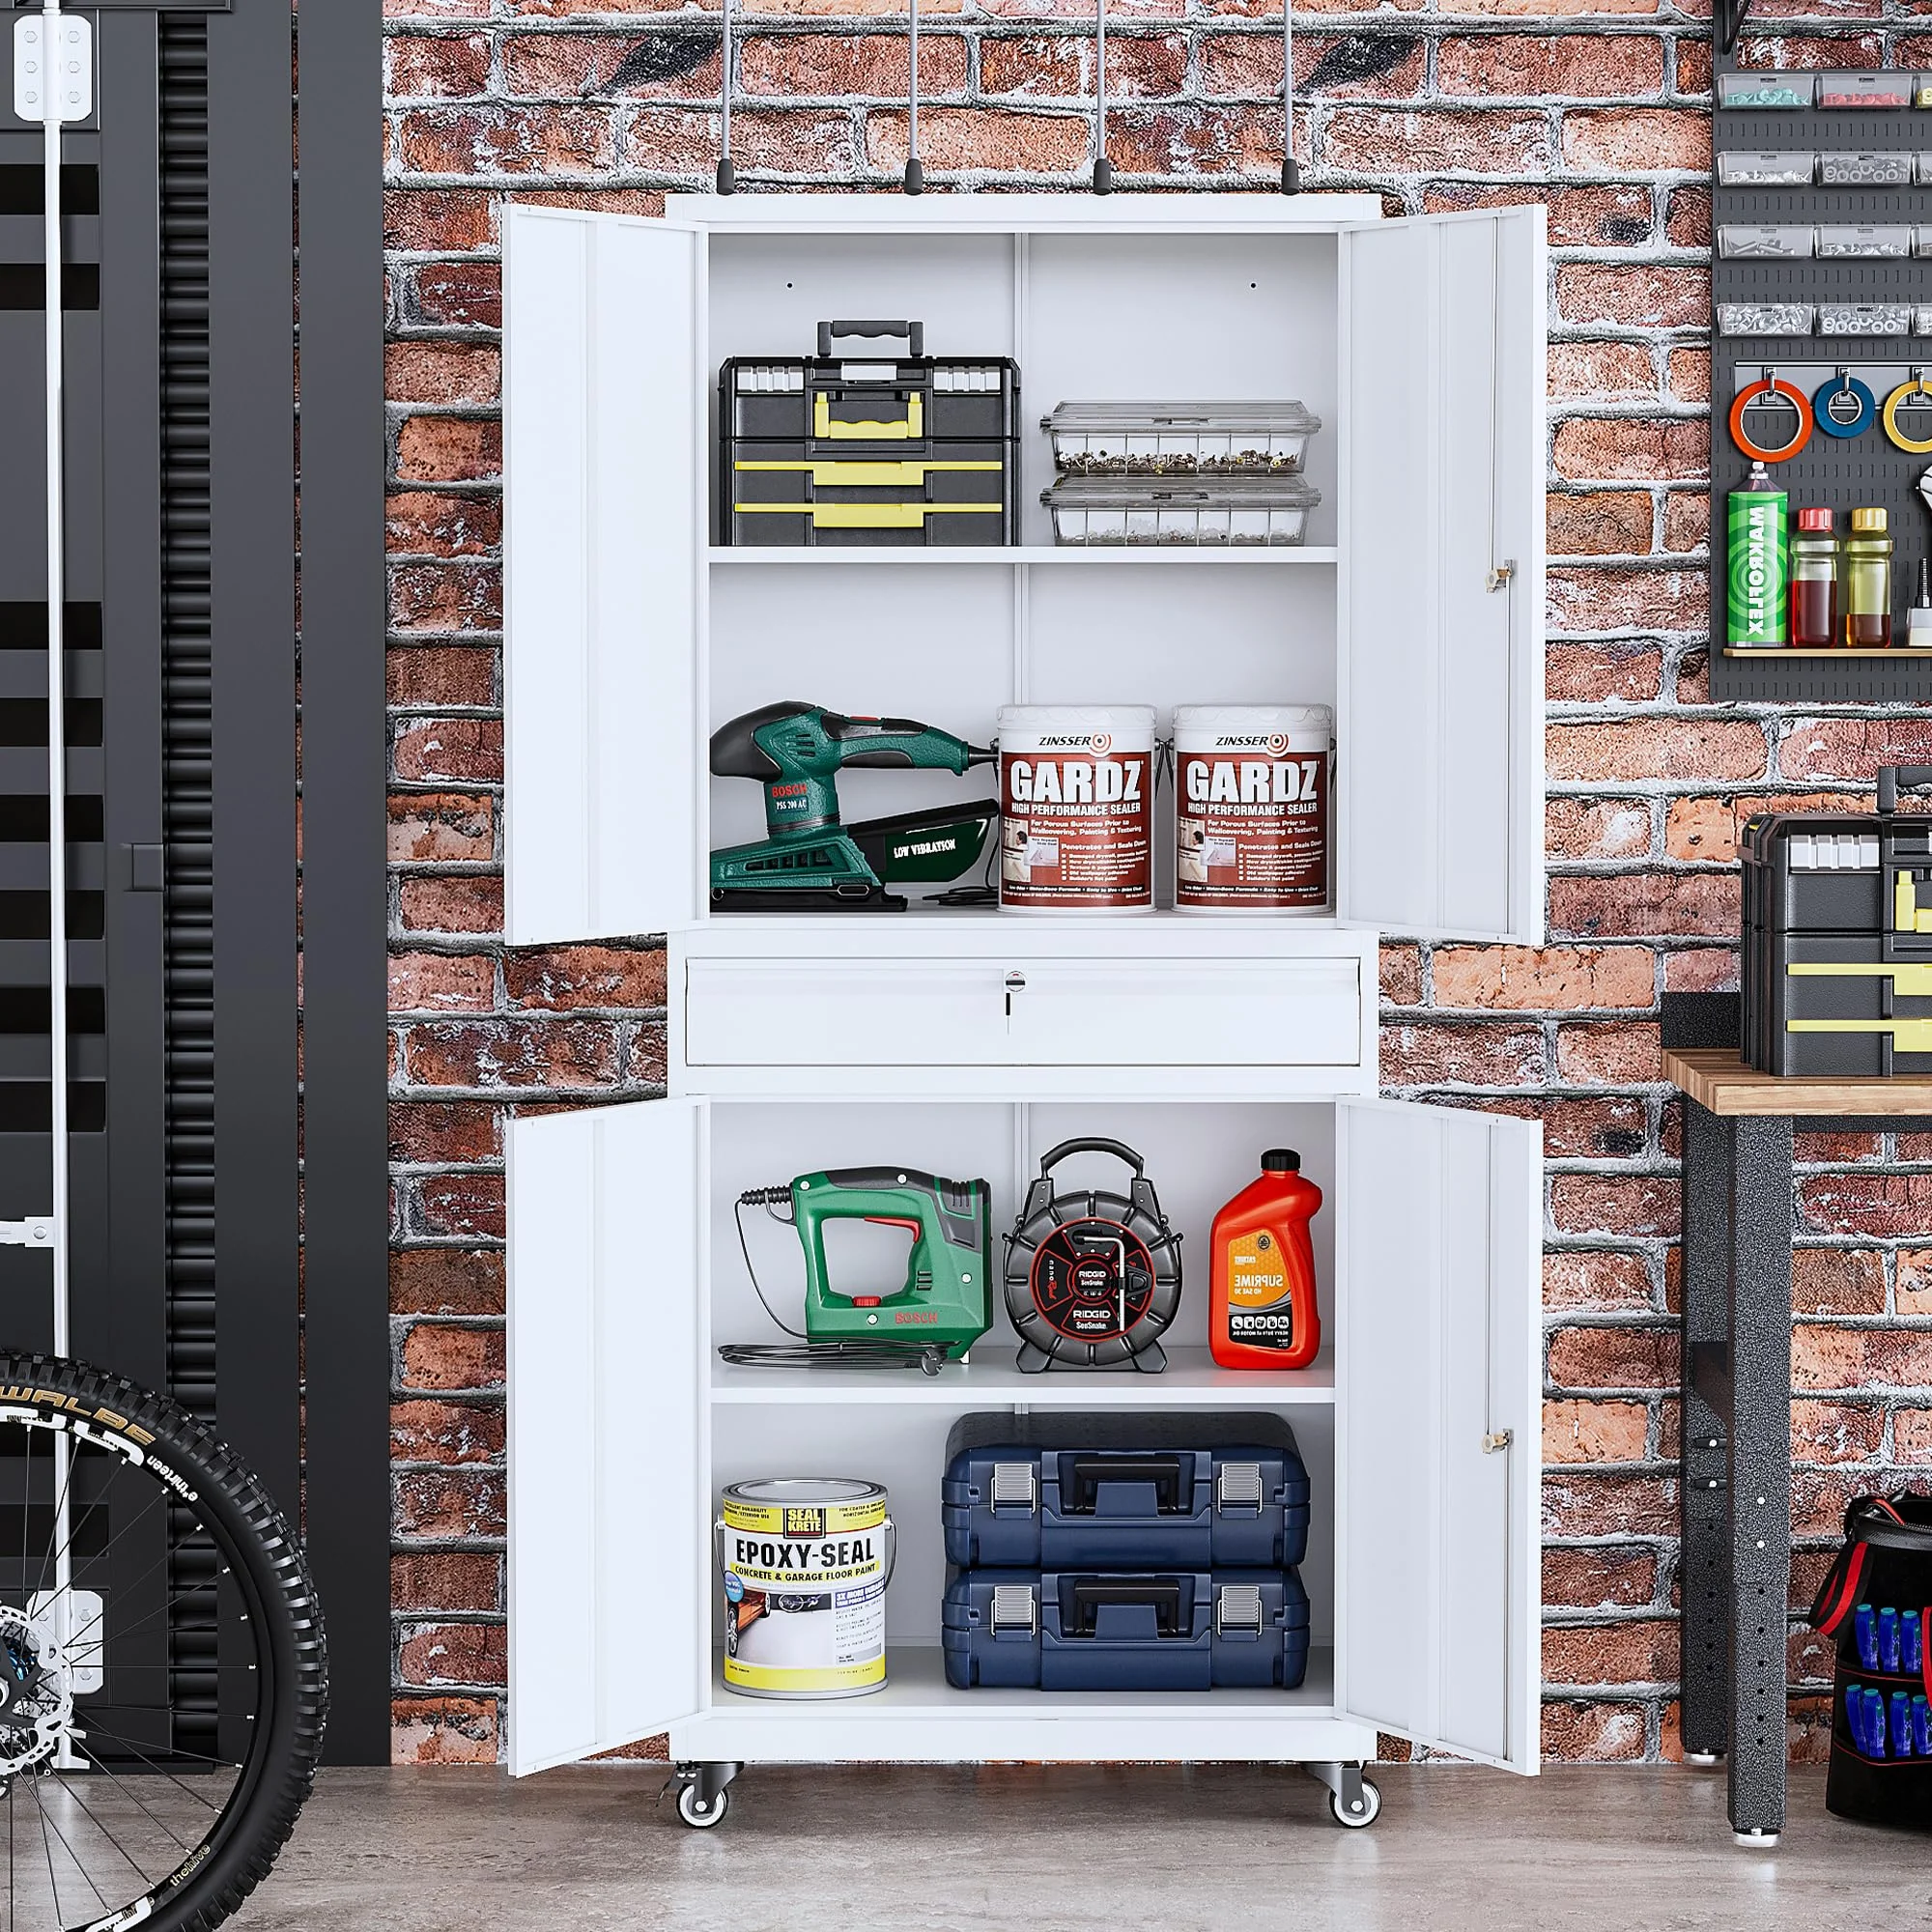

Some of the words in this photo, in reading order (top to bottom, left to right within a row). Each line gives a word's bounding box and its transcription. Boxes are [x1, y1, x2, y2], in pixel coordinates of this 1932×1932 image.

[1038, 736, 1092, 747] ZINSSER
[1215, 736, 1268, 747] ZINSSER
[1010, 760, 1142, 803] GARDZ
[1186, 760, 1319, 803] GARDZ
[771, 782, 808, 798] BOSCH
[1011, 803, 1030, 813] HIGH
[1032, 804, 1109, 816] PERFORMANCE
[1111, 803, 1141, 814] SEALER
[1188, 802, 1206, 813] HIGH
[1208, 804, 1285, 816] PERFORMANCE
[1287, 802, 1317, 814] SEALER
[894, 846, 910, 858] LOW
[911, 838, 956, 857] VIBRATION
[895, 1312, 938, 1324] BOSCH
[1073, 1310, 1111, 1319] RIDGID
[787, 1508, 821, 1520] SEAL
[787, 1520, 821, 1532] KRETE
[736, 1538, 875, 1569] EPOXY-SEAL
[735, 1566, 772, 1580] CONCRETE
[775, 1573, 782, 1581] &
[785, 1572, 823, 1581] GARAGE
[826, 1570, 852, 1580] FLOOR
[856, 1563, 876, 1577] PAINT
